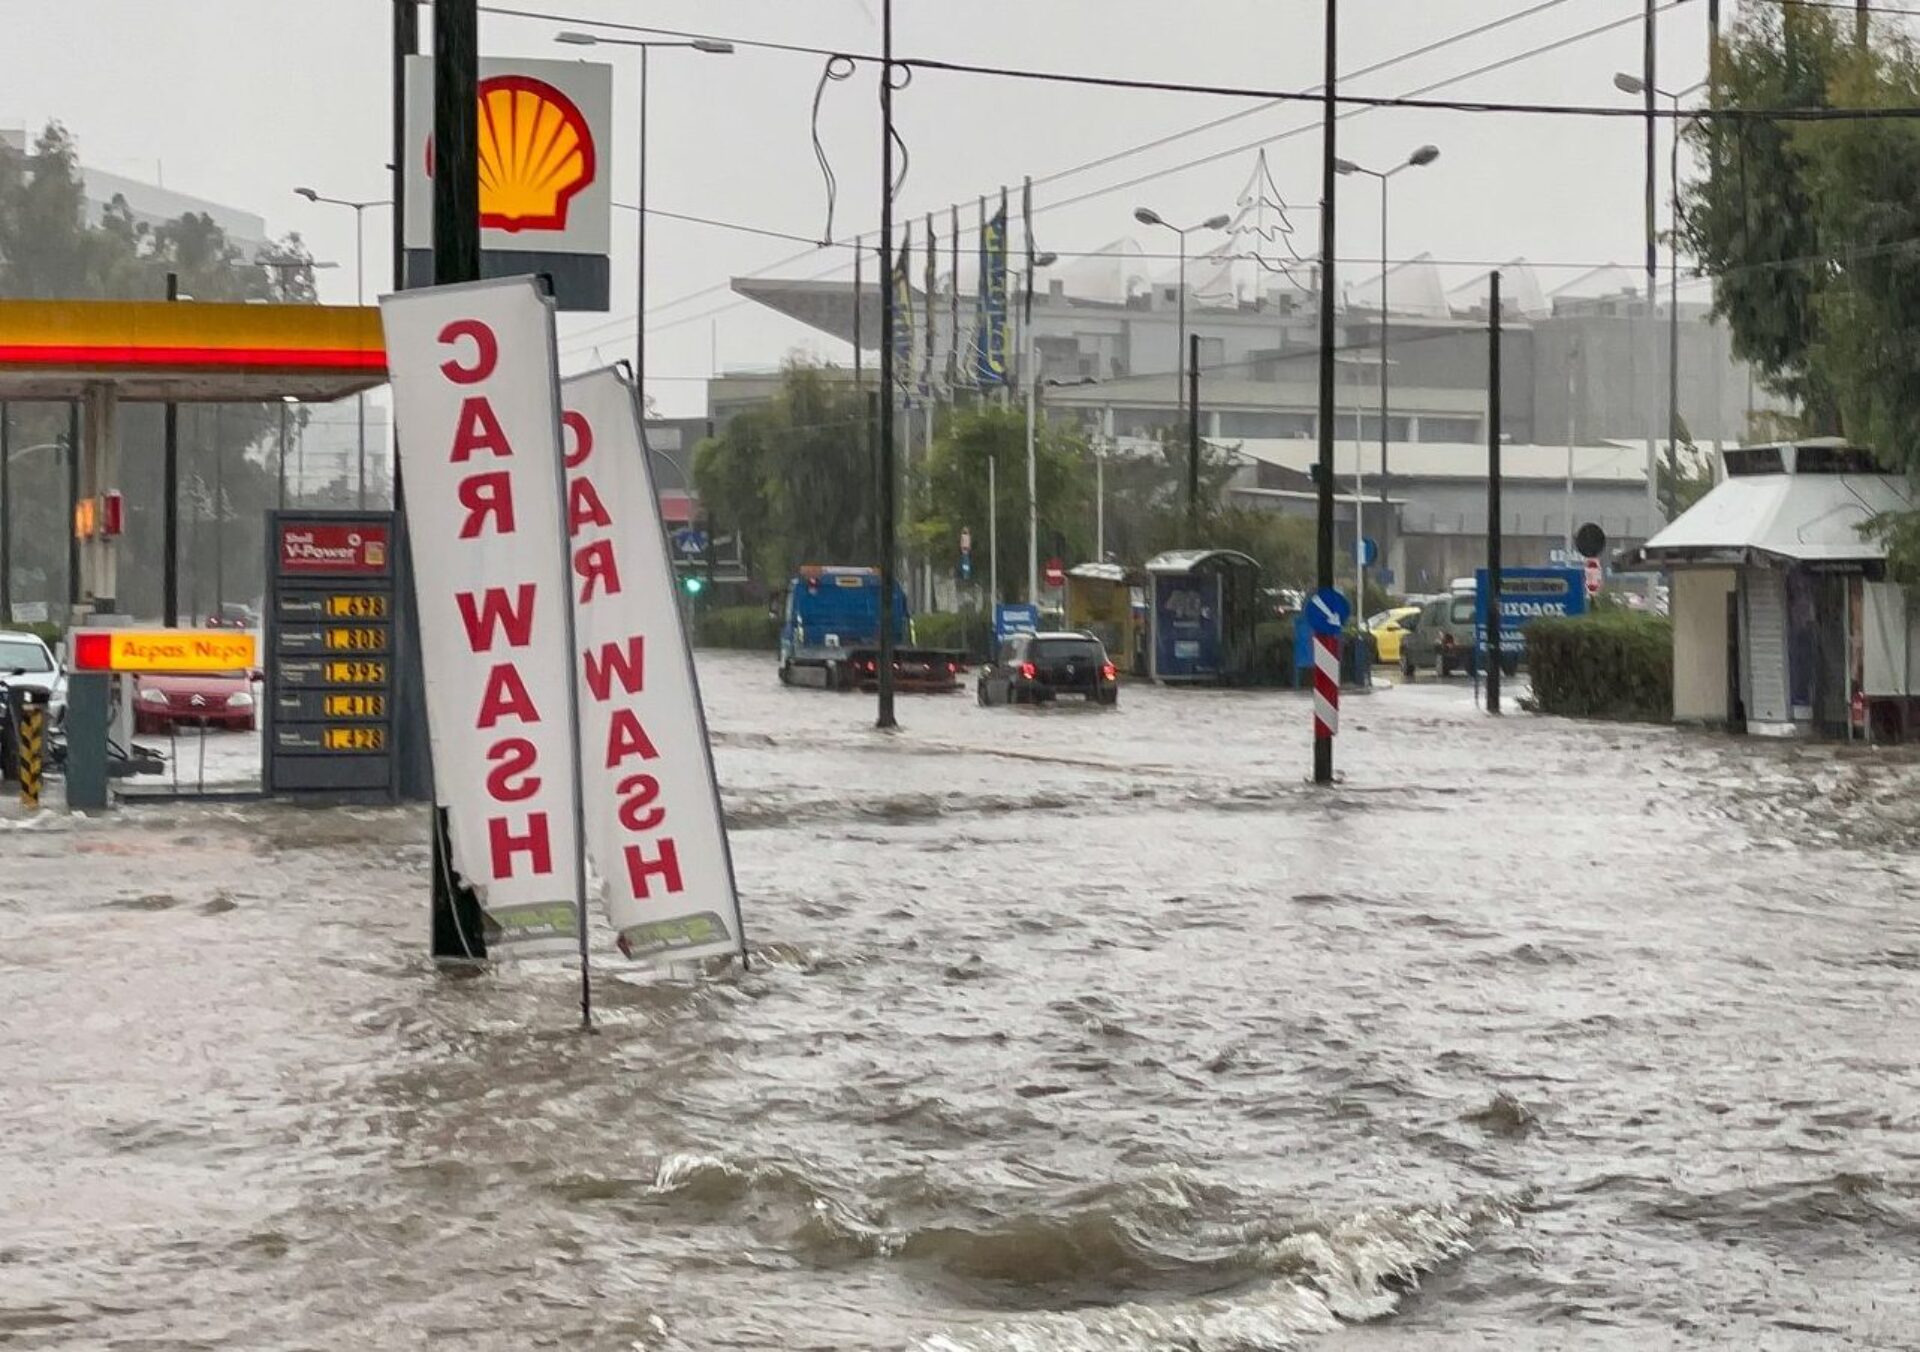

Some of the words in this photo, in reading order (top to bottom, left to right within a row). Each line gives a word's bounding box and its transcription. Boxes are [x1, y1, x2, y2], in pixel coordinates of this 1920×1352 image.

[285, 543, 355, 557] V-Power
[329, 595, 384, 616] 1.698
[195, 641, 248, 662] Νερο
